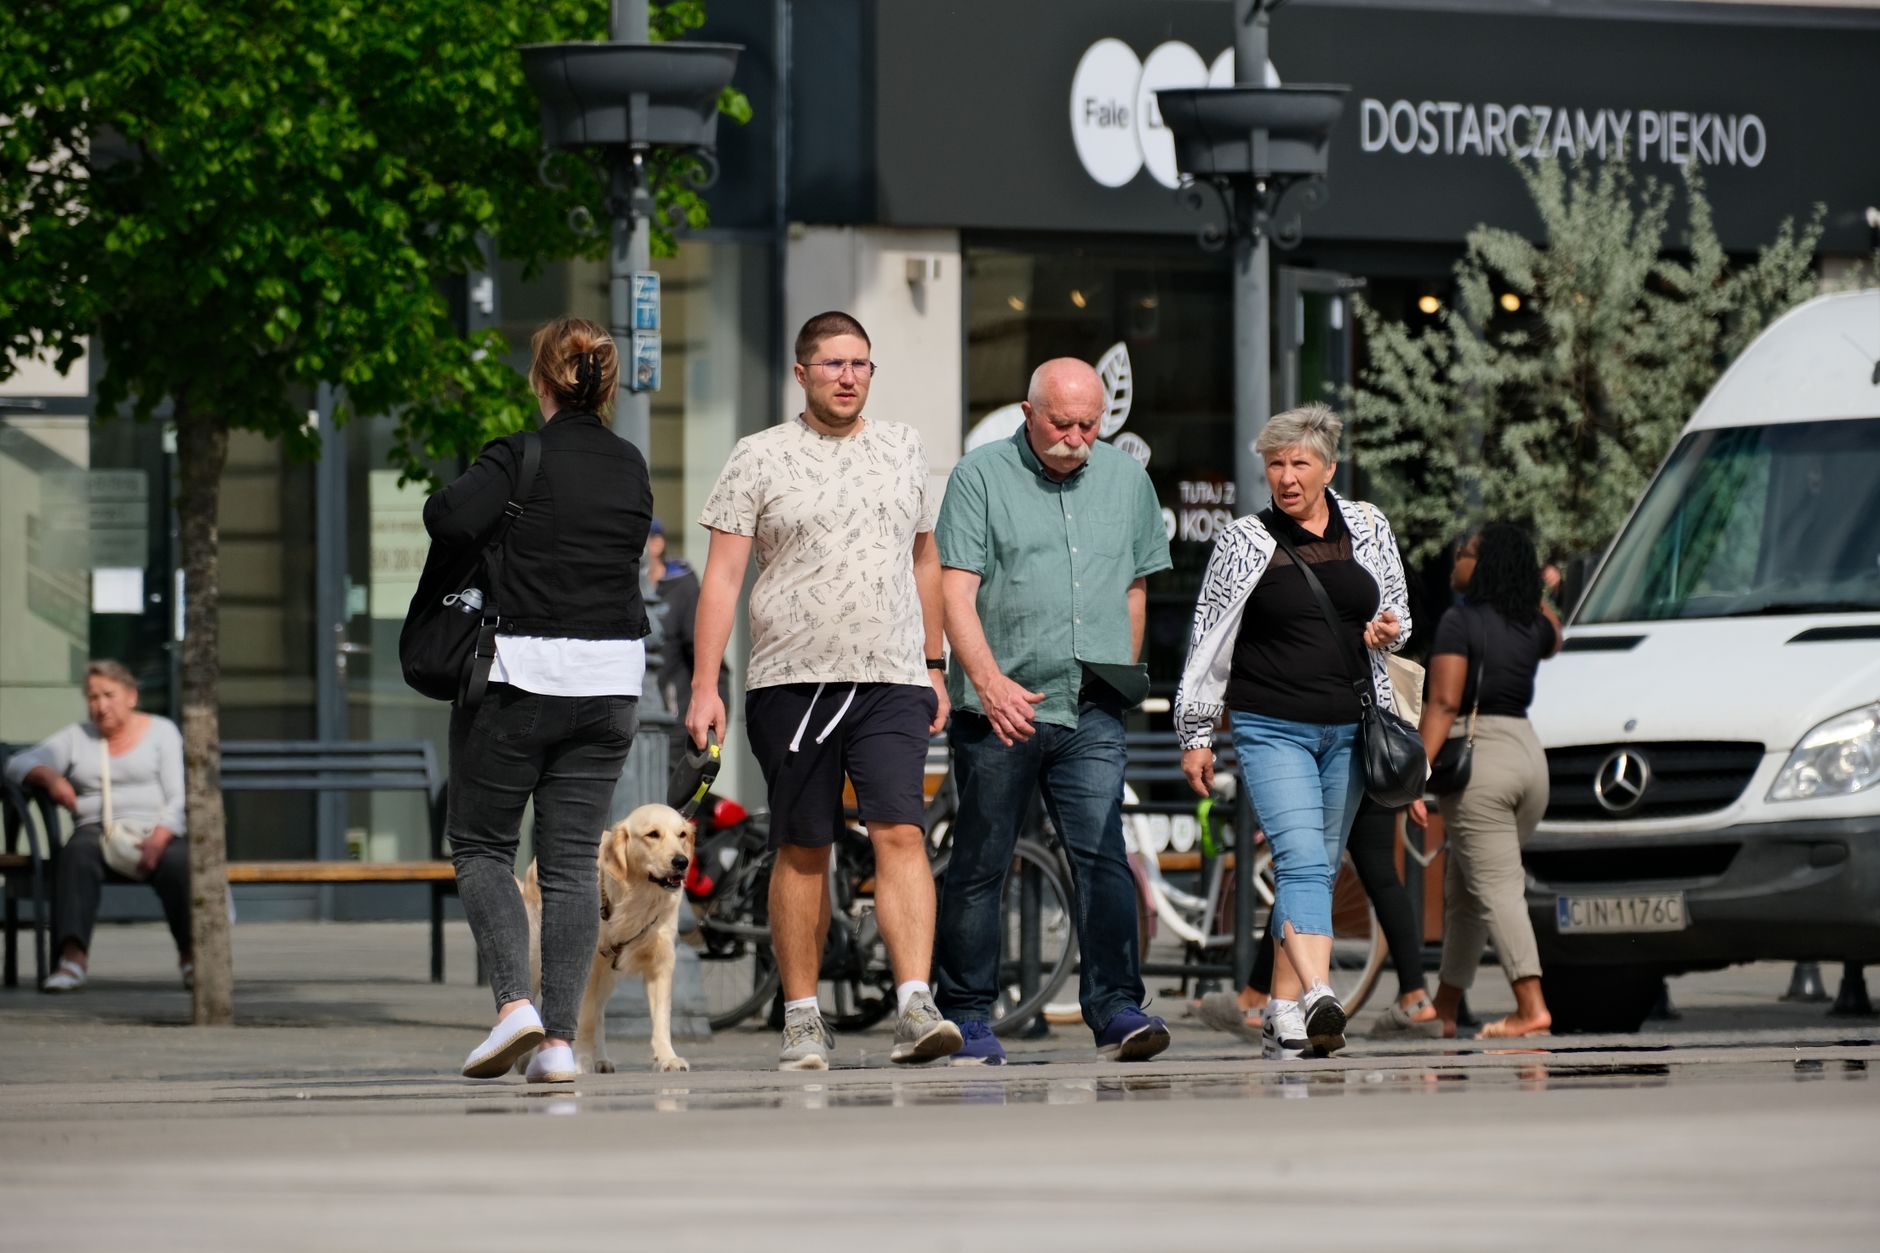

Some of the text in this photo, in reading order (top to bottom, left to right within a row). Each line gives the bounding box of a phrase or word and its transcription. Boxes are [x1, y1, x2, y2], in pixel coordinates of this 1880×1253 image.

[1084, 97, 1129, 129] Fale
[1361, 98, 1632, 160] DOSTARCZAMY
[1179, 480, 1223, 504] TUTAJ
